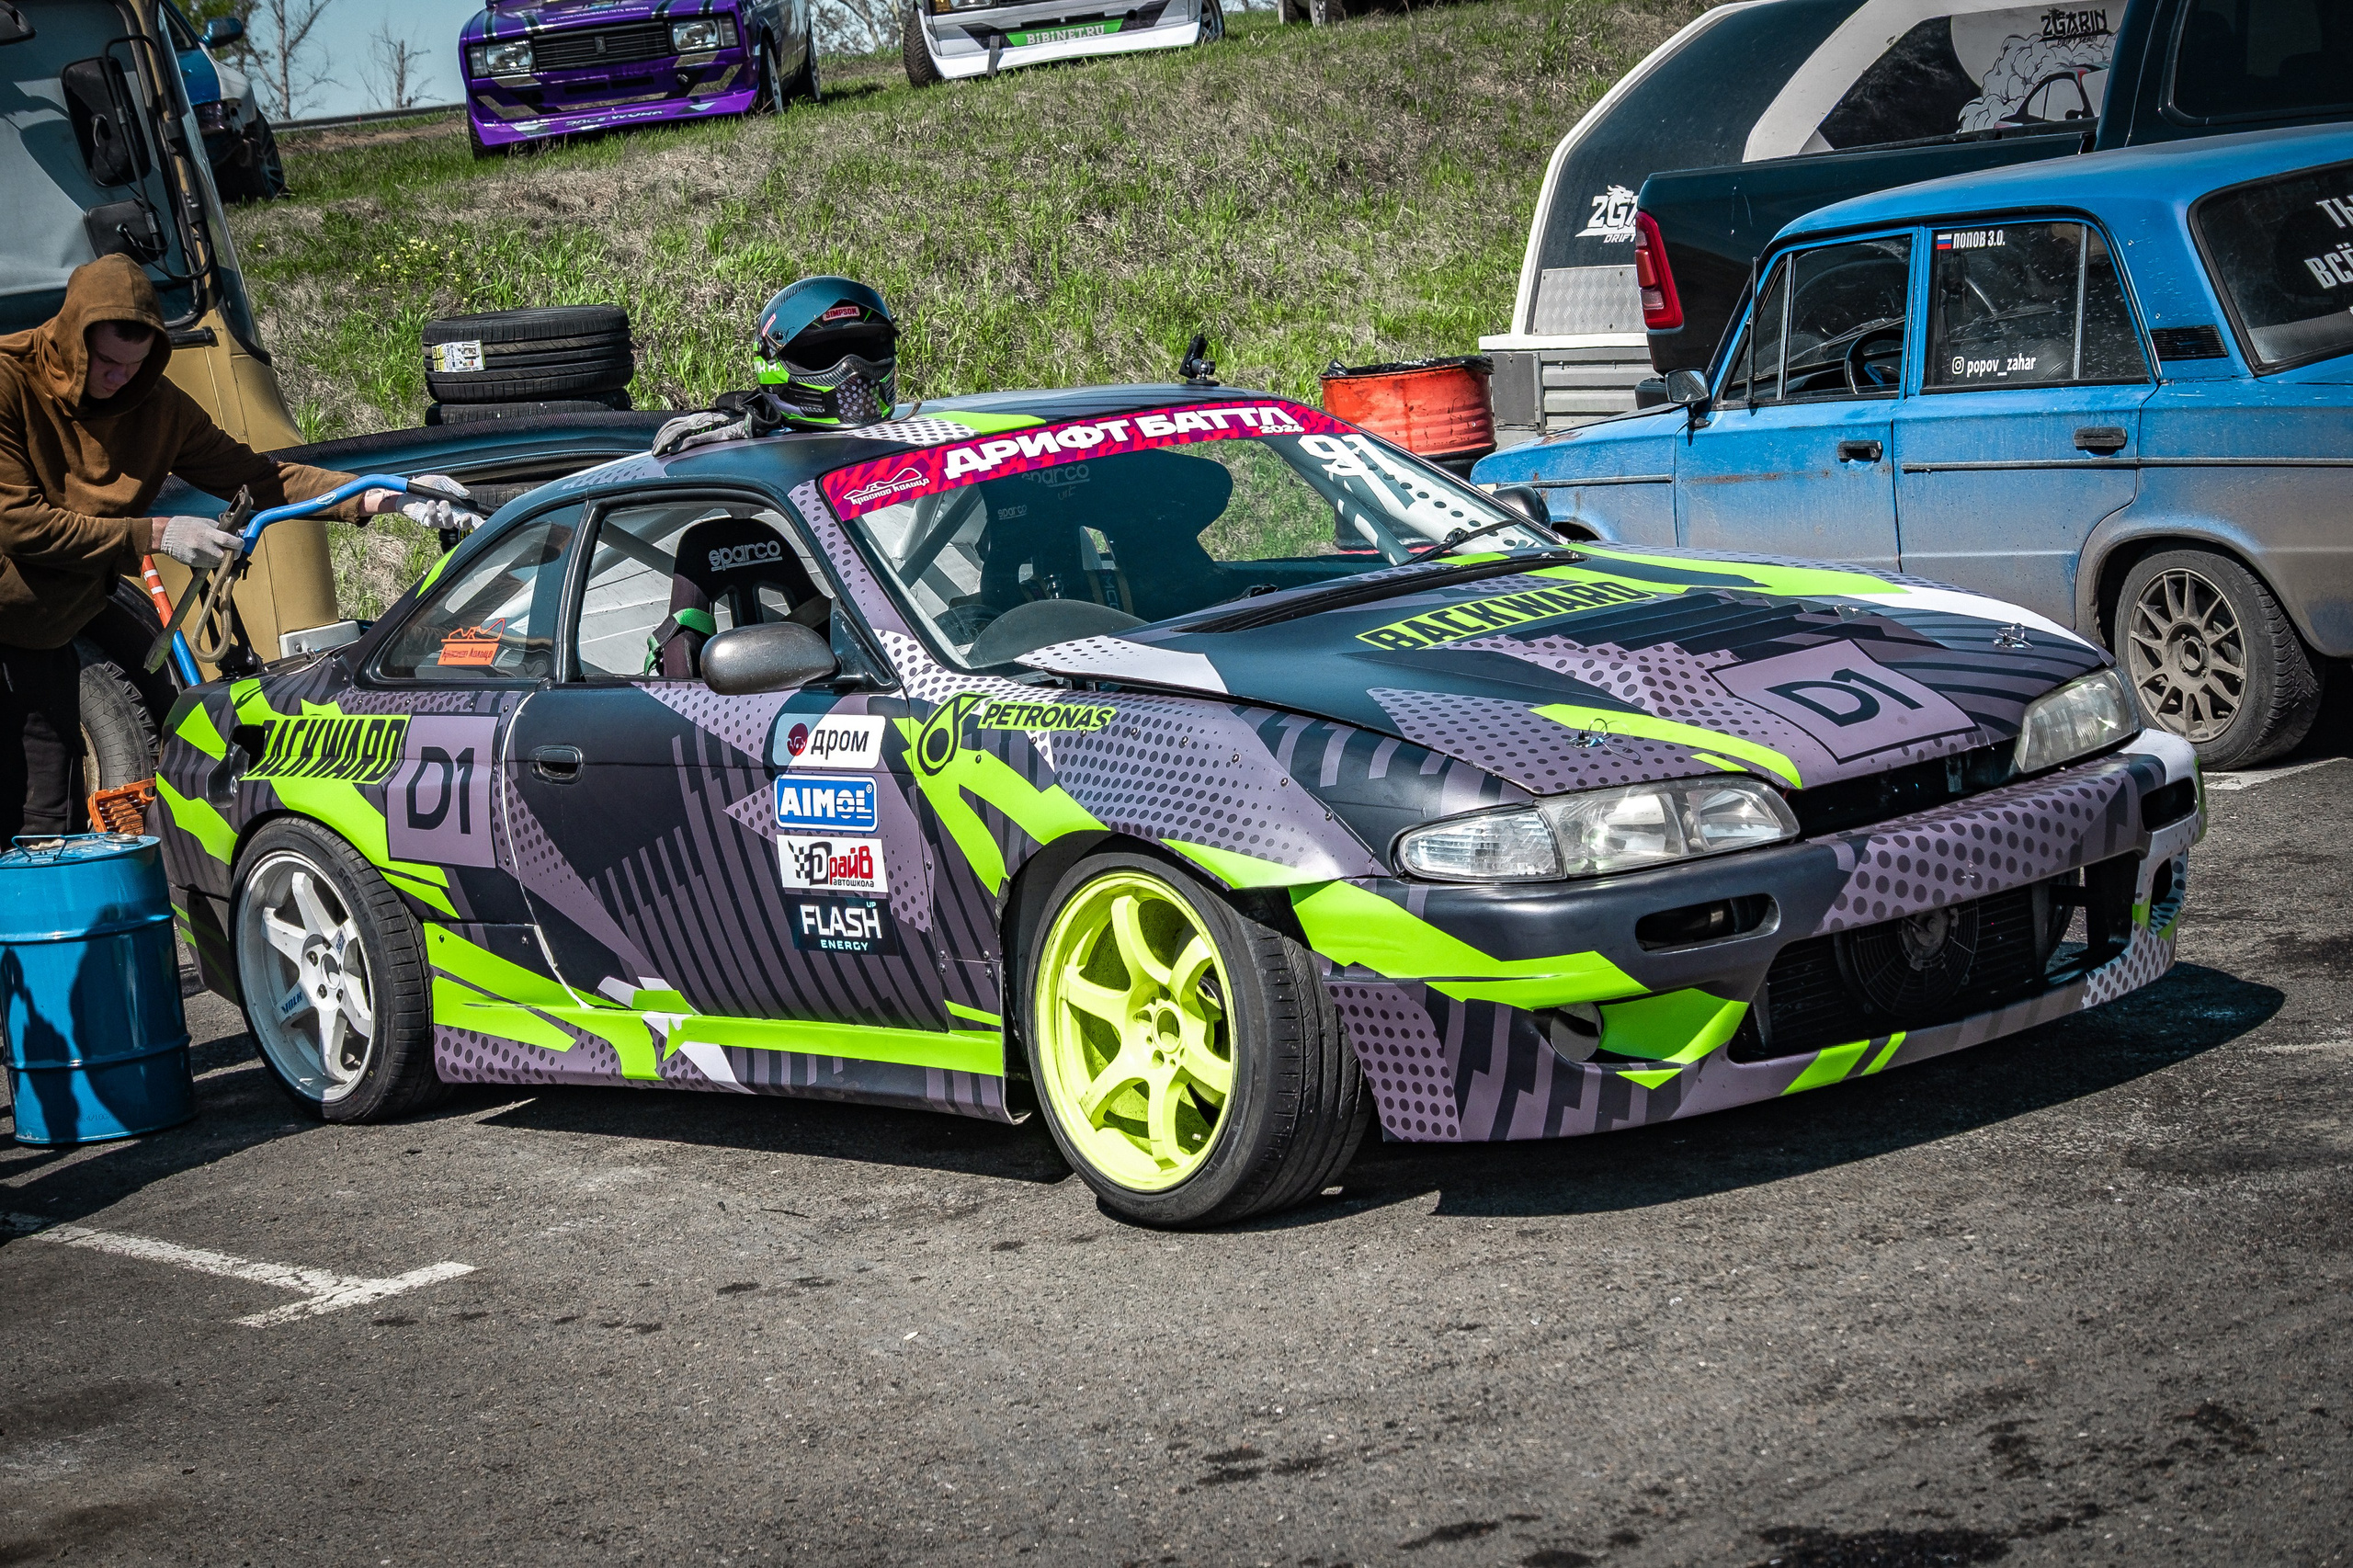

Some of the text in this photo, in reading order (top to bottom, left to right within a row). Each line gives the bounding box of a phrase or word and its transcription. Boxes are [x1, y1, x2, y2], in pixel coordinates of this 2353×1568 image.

[1603, 233, 1636, 244] DRIFT
[1952, 231, 1986, 249] ПОПОВ
[825, 307, 858, 319] SIMPSON
[1966, 352, 2036, 378] popov_zahar
[943, 406, 1299, 480] ДРИФТ БАТТЛ
[1297, 434, 1403, 476] 91
[708, 540, 781, 571] sparco
[1364, 581, 1653, 650] BACKWARD
[1764, 667, 1925, 727] D1
[982, 703, 1112, 728] PETRONAS
[811, 729, 870, 760] дром
[406, 746, 475, 835] D1
[833, 879, 874, 888] автошкола
[800, 904, 882, 938] FLASH
[820, 939, 869, 950] ENERGY
